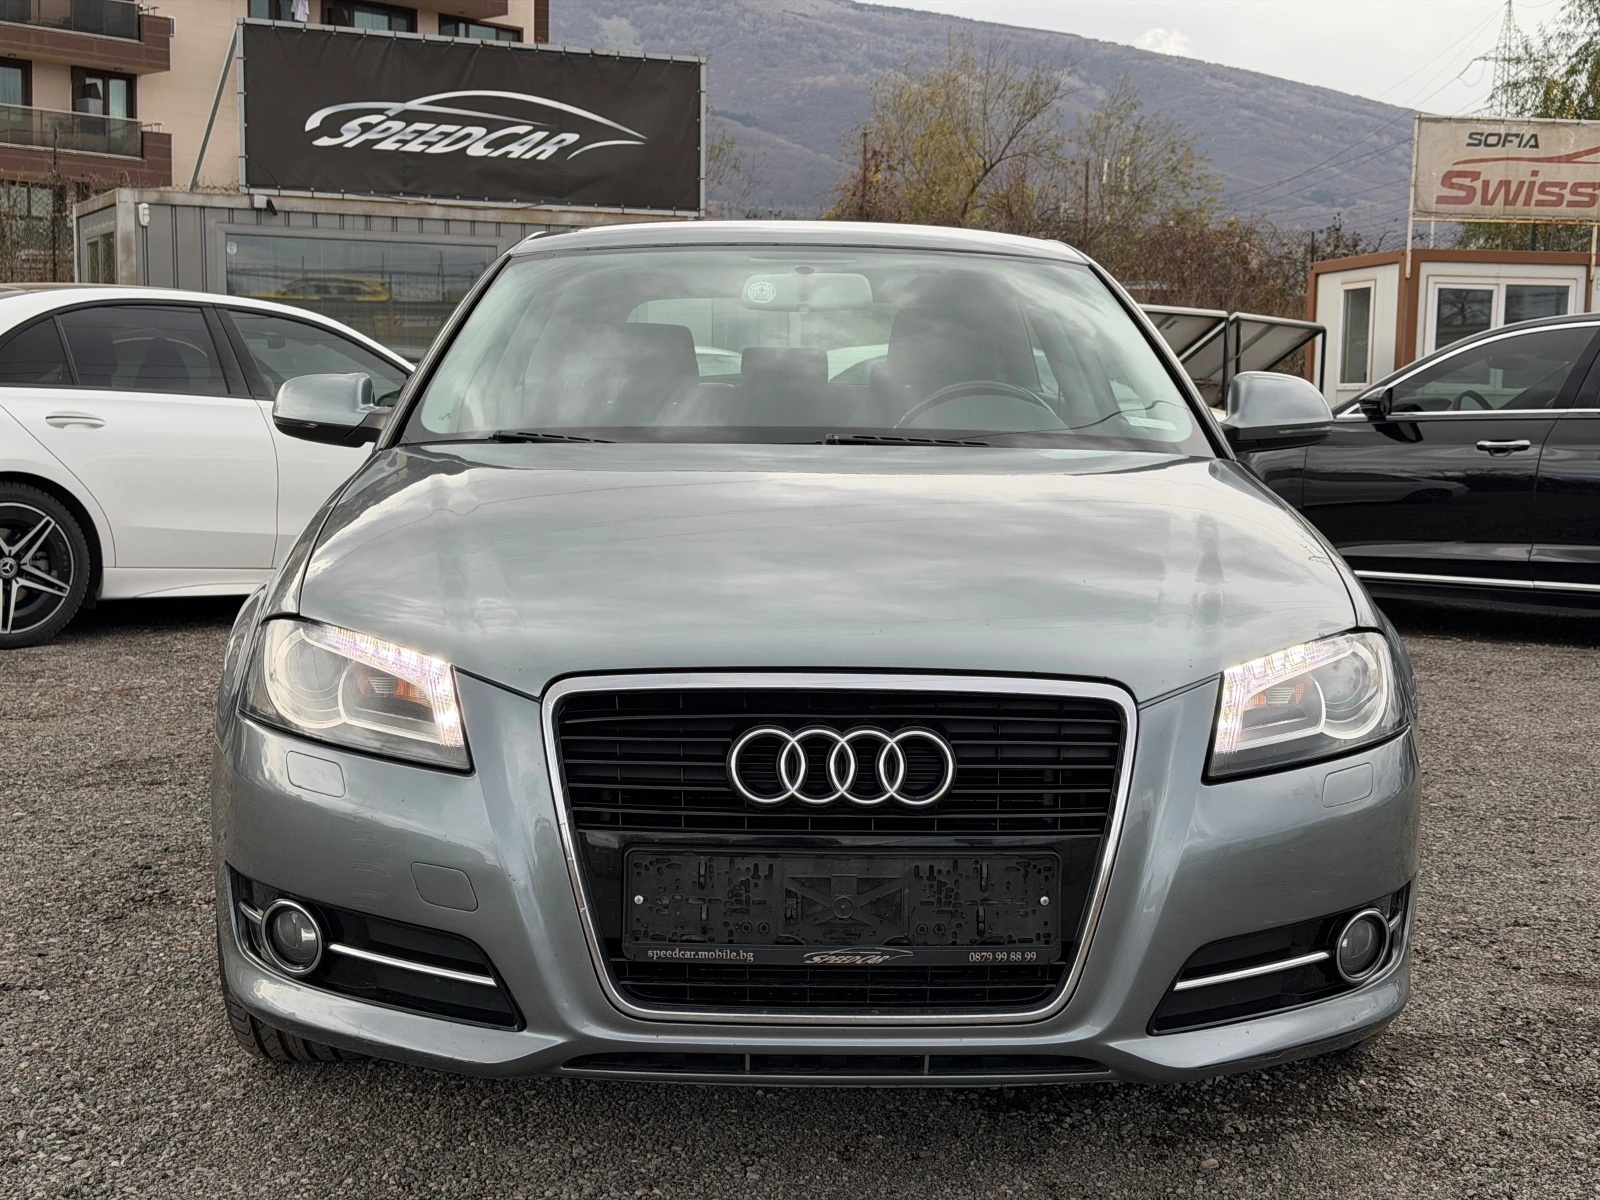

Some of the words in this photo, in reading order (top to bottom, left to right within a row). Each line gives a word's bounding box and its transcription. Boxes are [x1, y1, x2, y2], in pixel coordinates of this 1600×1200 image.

[1466, 131, 1540, 149] SOFIA
[1435, 169, 1600, 209] Swiss
[647, 948, 755, 963] speedcar.mobile.bg
[968, 952, 993, 962] 0879
[995, 951, 1008, 962] 99
[1009, 951, 1022, 962] 88
[1024, 951, 1037, 962] 99
